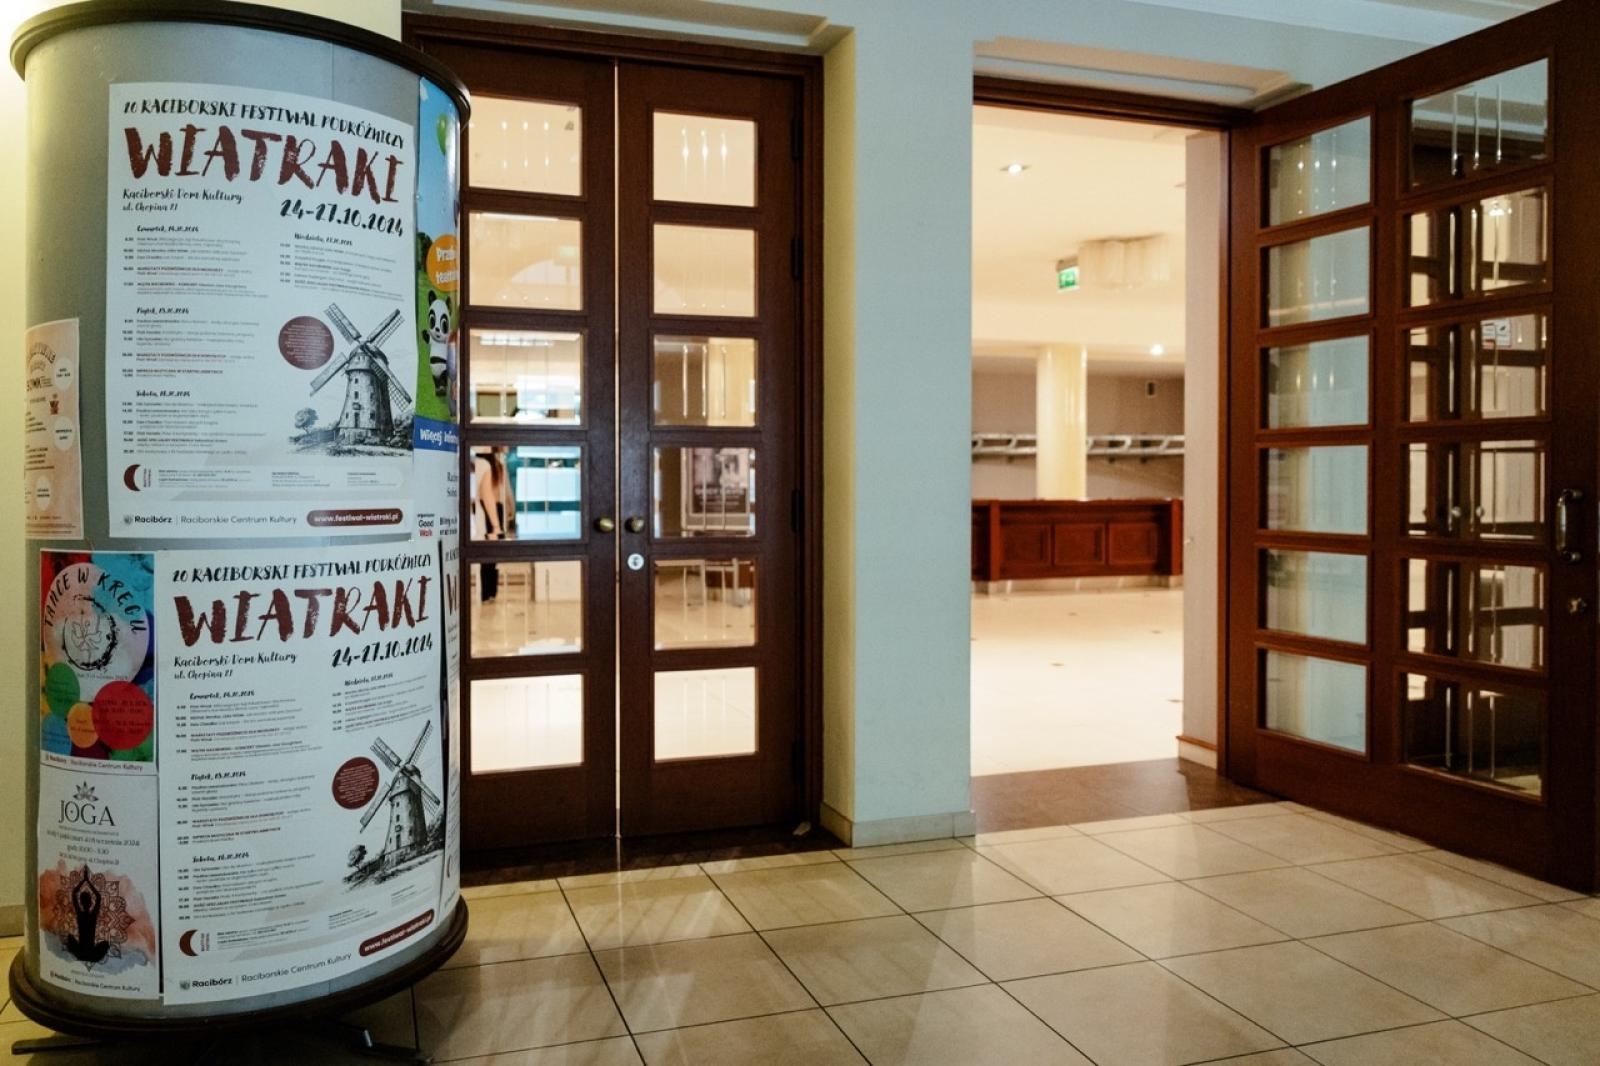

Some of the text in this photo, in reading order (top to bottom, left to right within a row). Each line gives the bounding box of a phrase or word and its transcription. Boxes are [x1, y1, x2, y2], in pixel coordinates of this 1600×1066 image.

[140, 98, 238, 118] RACIBORSKI
[241, 103, 320, 127] FESTIWAL
[321, 114, 404, 149] PODRÓŻNICZY
[124, 123, 404, 205] WIATRAKI
[123, 187, 242, 205] Raciborski Dom Kultury
[280, 198, 404, 237] 24-27.10.2024
[134, 514, 297, 525] Racibórz Raciborskie Centrum Kultury
[78, 567, 89, 584] W
[192, 564, 290, 583] RACIBORSKI
[294, 561, 362, 580] FESTIWAL
[173, 575, 432, 647] WIATRAKI
[173, 651, 296, 668] Raciborski Dom Kultury
[331, 632, 433, 668] 24-27.10.2024
[58, 799, 116, 827] JOGA
[192, 952, 352, 988] Racibórz Raciborskie Centrum Kultury
